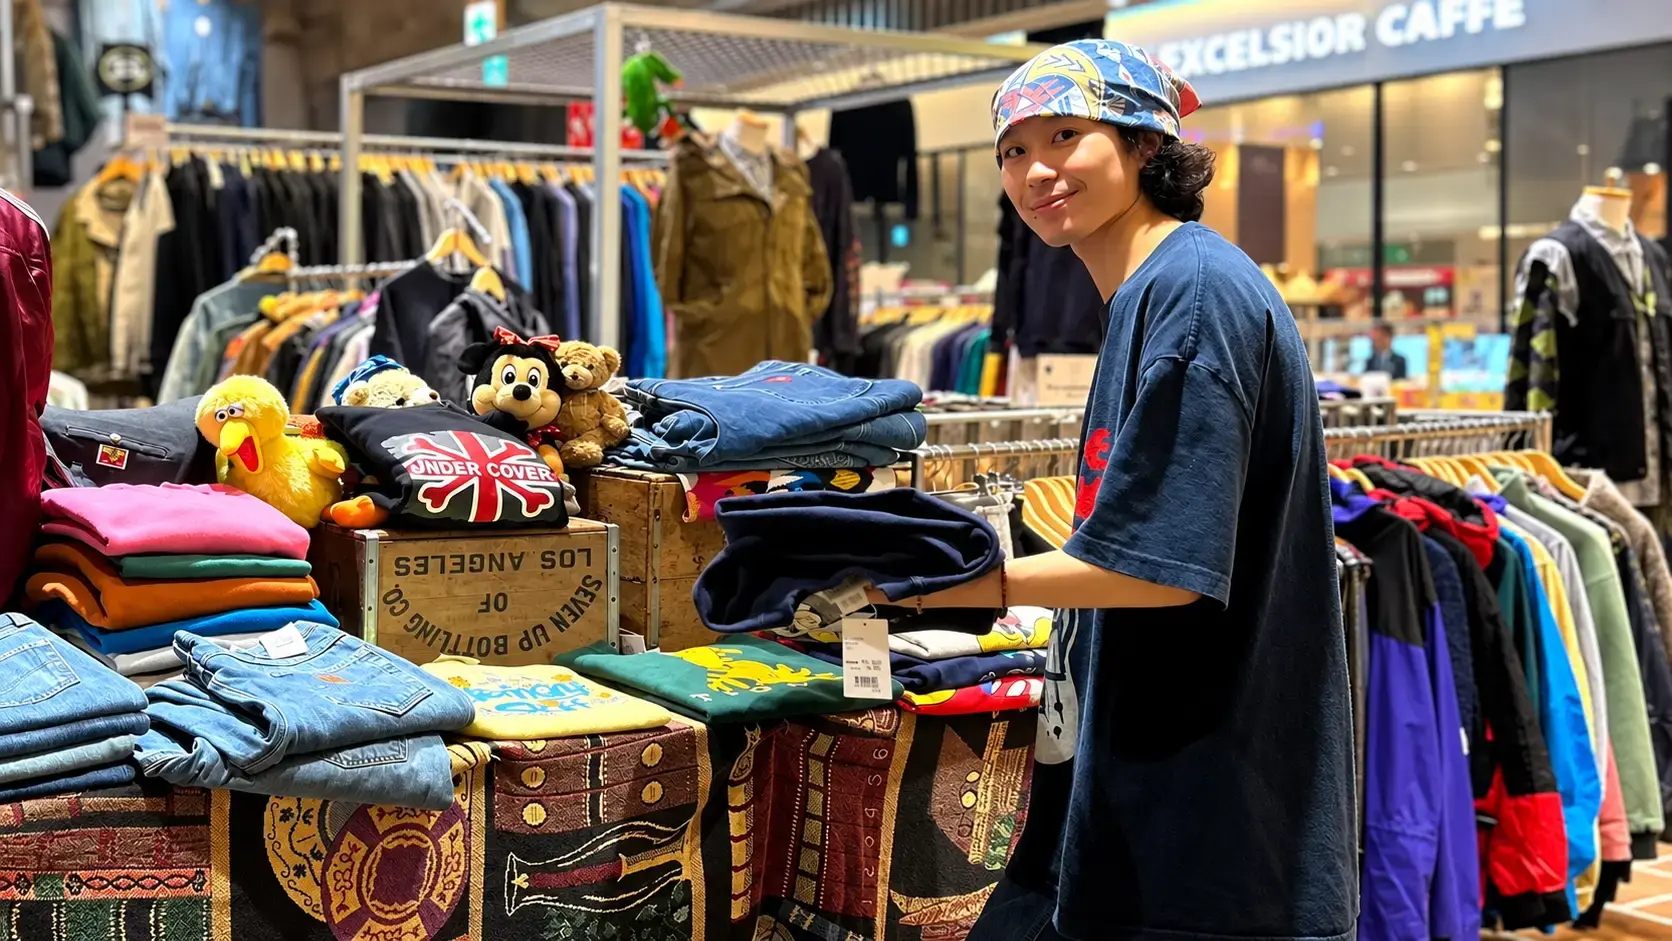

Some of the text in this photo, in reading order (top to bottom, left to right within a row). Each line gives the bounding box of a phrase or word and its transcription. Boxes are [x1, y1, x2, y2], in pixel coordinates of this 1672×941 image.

[1158, 11, 1367, 77] EXCELSIOR
[486, 462, 555, 481] COVER
[394, 548, 592, 577] LOS ANGELES
[478, 592, 508, 613] OF
[549, 574, 603, 632] SEVEN
[403, 612, 508, 657] BOTTLING
[518, 623, 551, 652] UP
